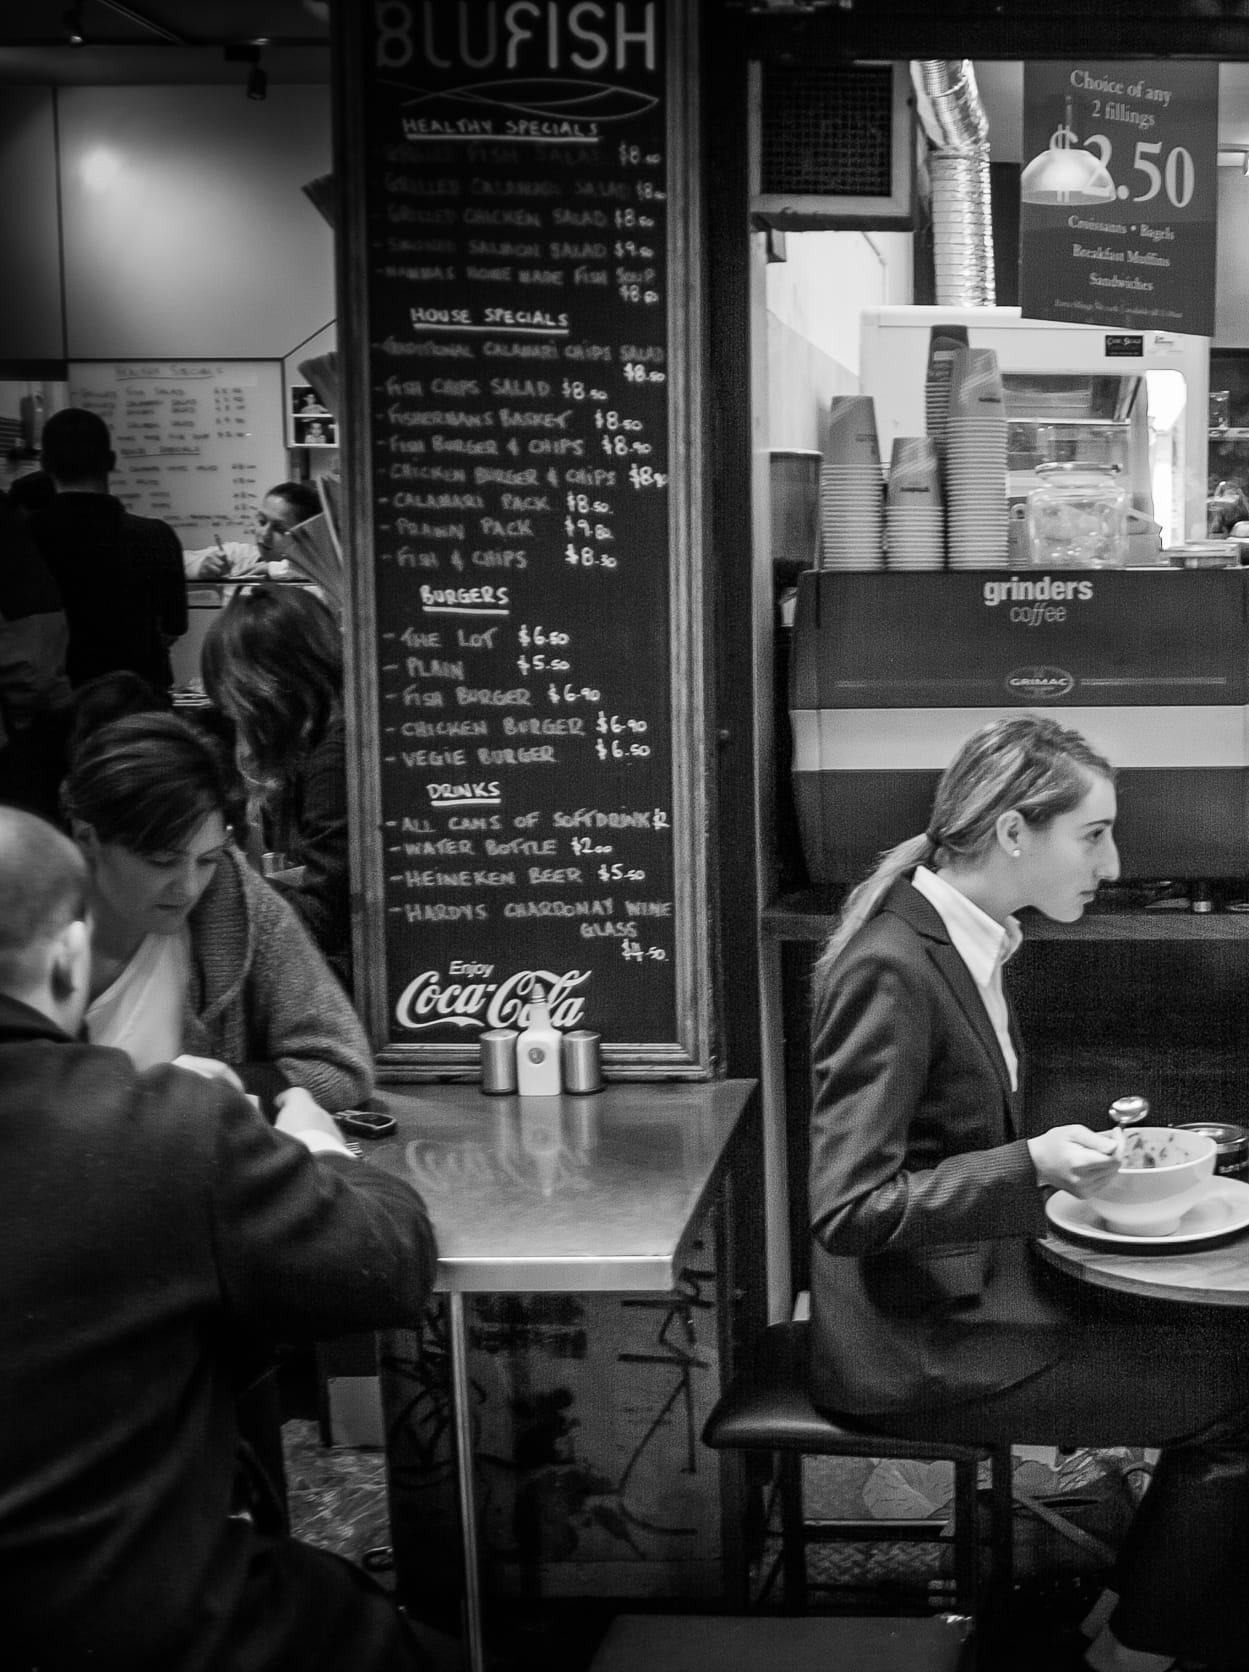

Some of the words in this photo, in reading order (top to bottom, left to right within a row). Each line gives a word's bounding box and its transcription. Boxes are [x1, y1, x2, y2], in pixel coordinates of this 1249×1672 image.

[375, 1, 656, 69] BLUFISH
[1070, 69, 1125, 95] Choice
[1127, 82, 1144, 99] of
[1145, 86, 1173, 106] any
[1091, 100, 1101, 118] 2
[1105, 103, 1156, 130] fillings
[402, 117, 494, 135] HEALTHY
[505, 119, 600, 138] SPECIALS
[409, 307, 472, 325] HOUSE
[484, 307, 569, 328] SPECIALS
[489, 377, 551, 398] SALAD
[419, 584, 510, 606] BURGERS
[983, 576, 1094, 606] grinders
[1010, 602, 1068, 626] coffee
[401, 626, 441, 649] THE
[456, 625, 499, 649] LOT
[517, 623, 570, 648] $6.50
[516, 653, 571, 676] $5.50
[400, 719, 489, 738] CHICKEN
[502, 715, 586, 737] BURGER
[477, 744, 556, 766] BURGER
[595, 737, 651, 761] $6.50
[426, 780, 501, 800] DRINKS
[513, 810, 542, 830] OF
[404, 838, 476, 857] WATER
[484, 838, 558, 857] BOTTLE
[404, 866, 516, 888] HEINEKEN
[528, 866, 584, 886] BEER
[579, 920, 639, 940] GLASS
[448, 960, 496, 979] Enjoy
